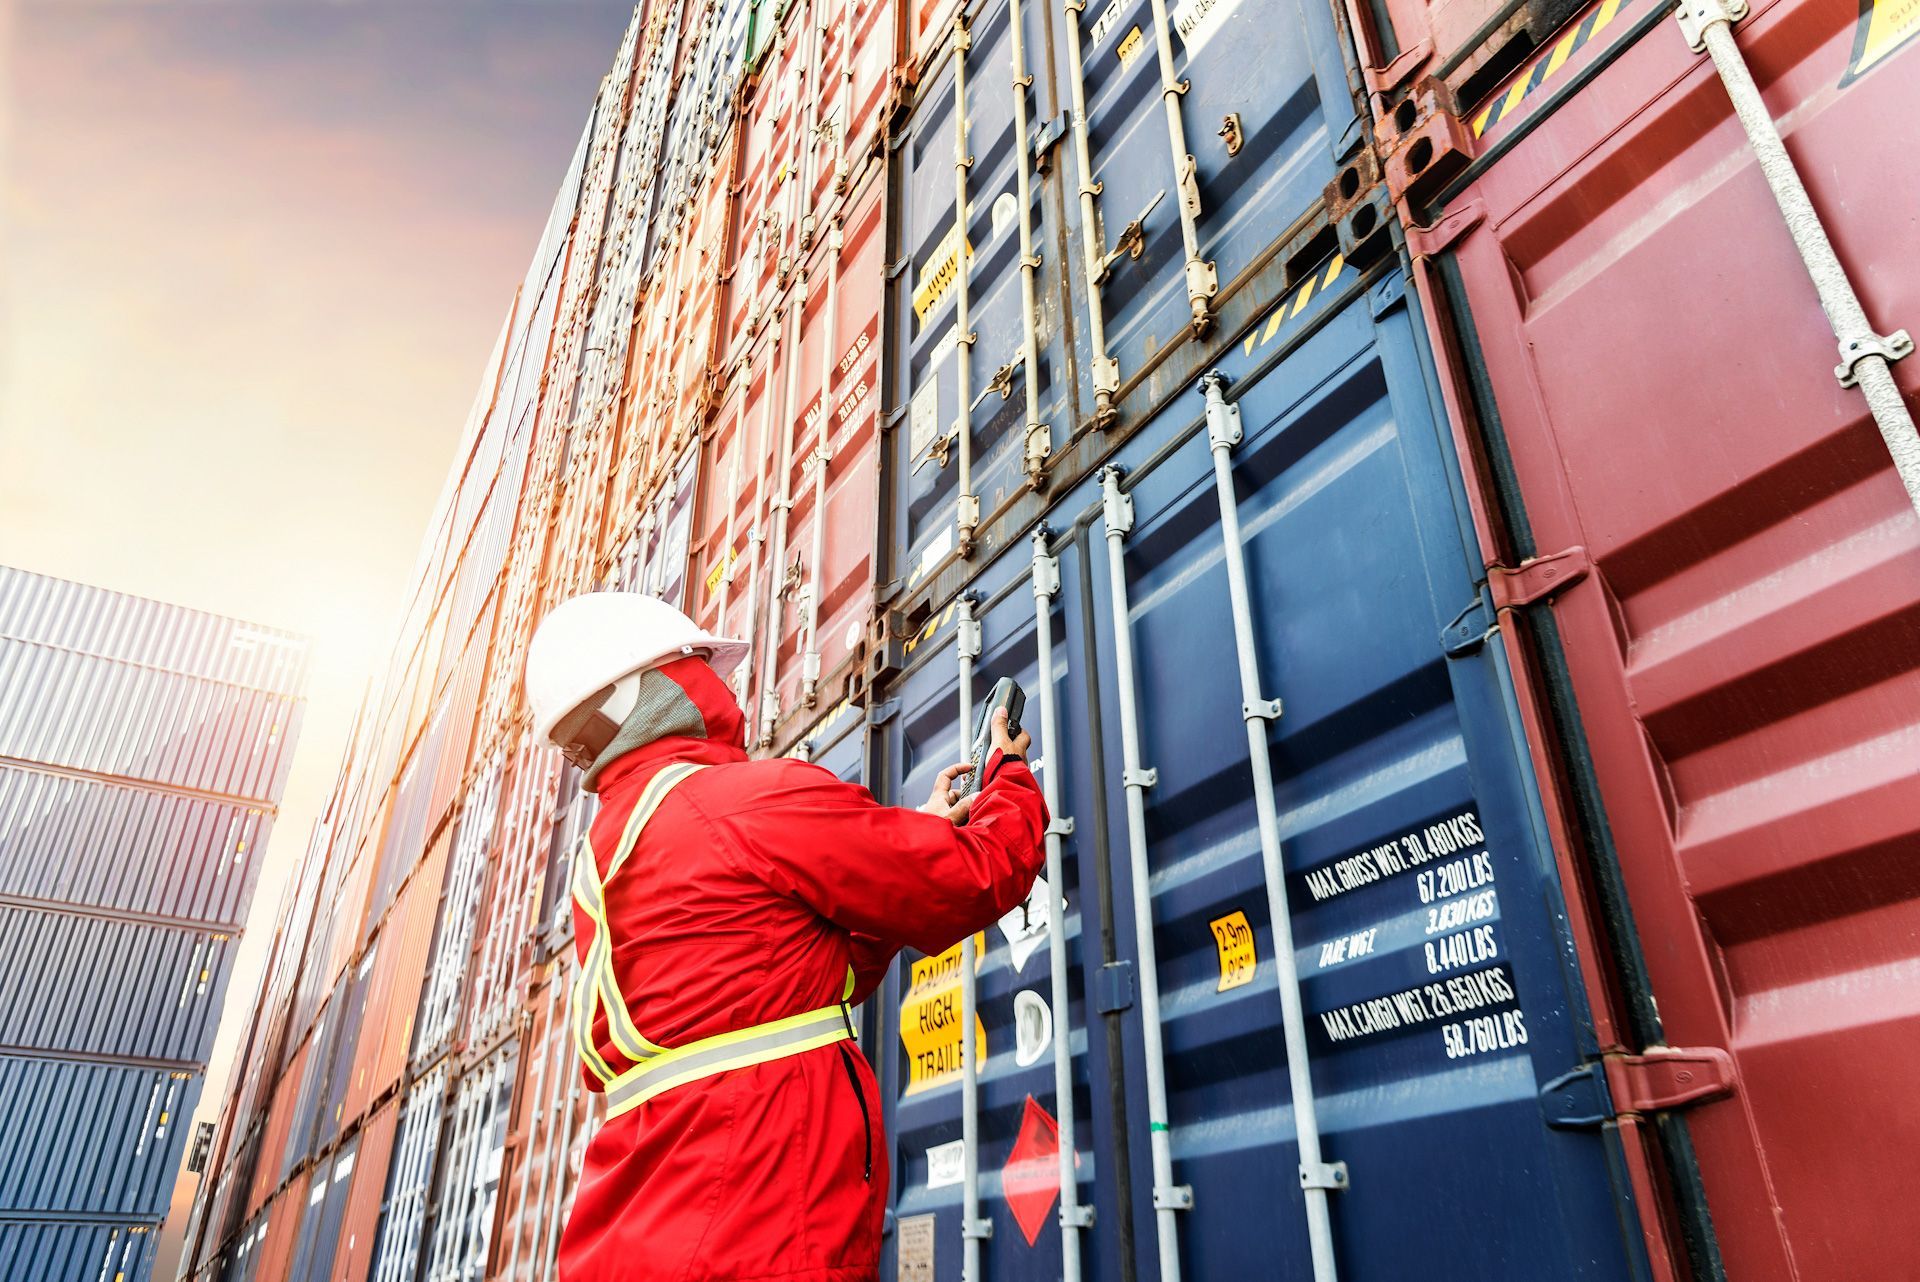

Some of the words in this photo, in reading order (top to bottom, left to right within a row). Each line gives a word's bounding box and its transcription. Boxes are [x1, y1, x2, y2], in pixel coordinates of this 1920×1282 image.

[1424, 925, 1498, 975] 8.440LBS
[919, 992, 956, 1035] HIGH
[918, 1039, 964, 1080] TRAILE
